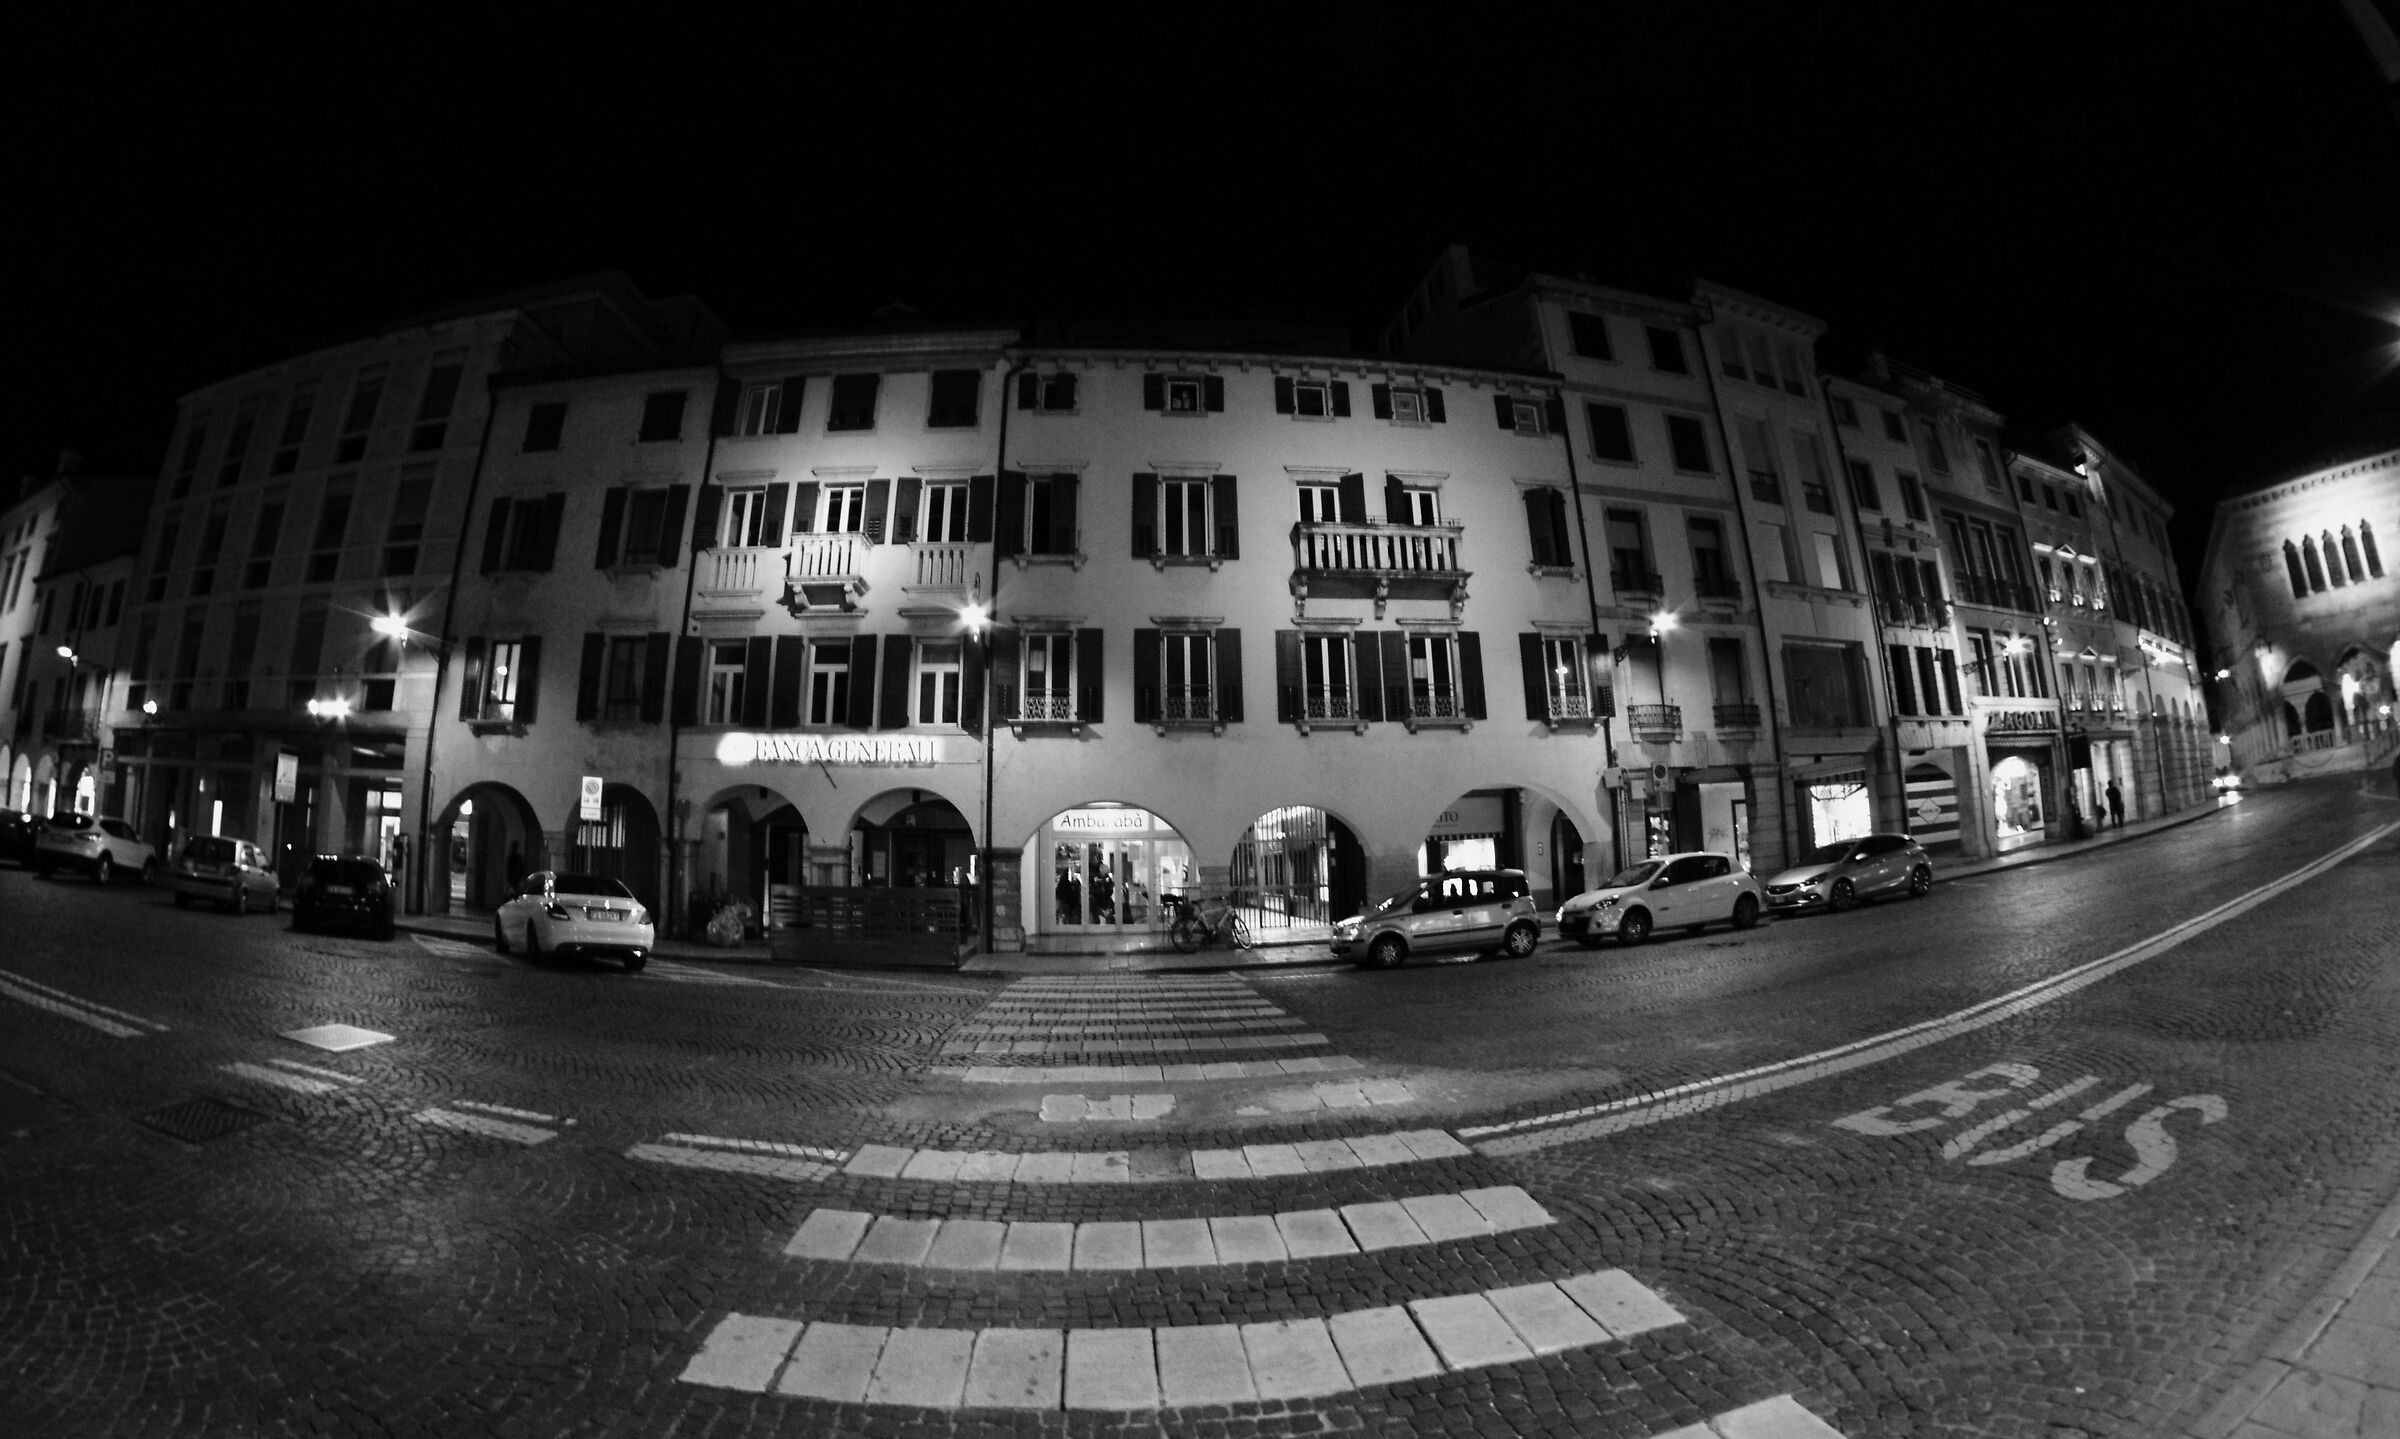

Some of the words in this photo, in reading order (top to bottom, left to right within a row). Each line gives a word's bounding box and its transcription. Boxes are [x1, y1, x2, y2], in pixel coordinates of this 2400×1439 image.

[756, 738, 823, 762] BANCA
[828, 738, 936, 764] GENERALI
[1060, 812, 1143, 828] Ambaabà
[1831, 1062, 2228, 1201] BUS
